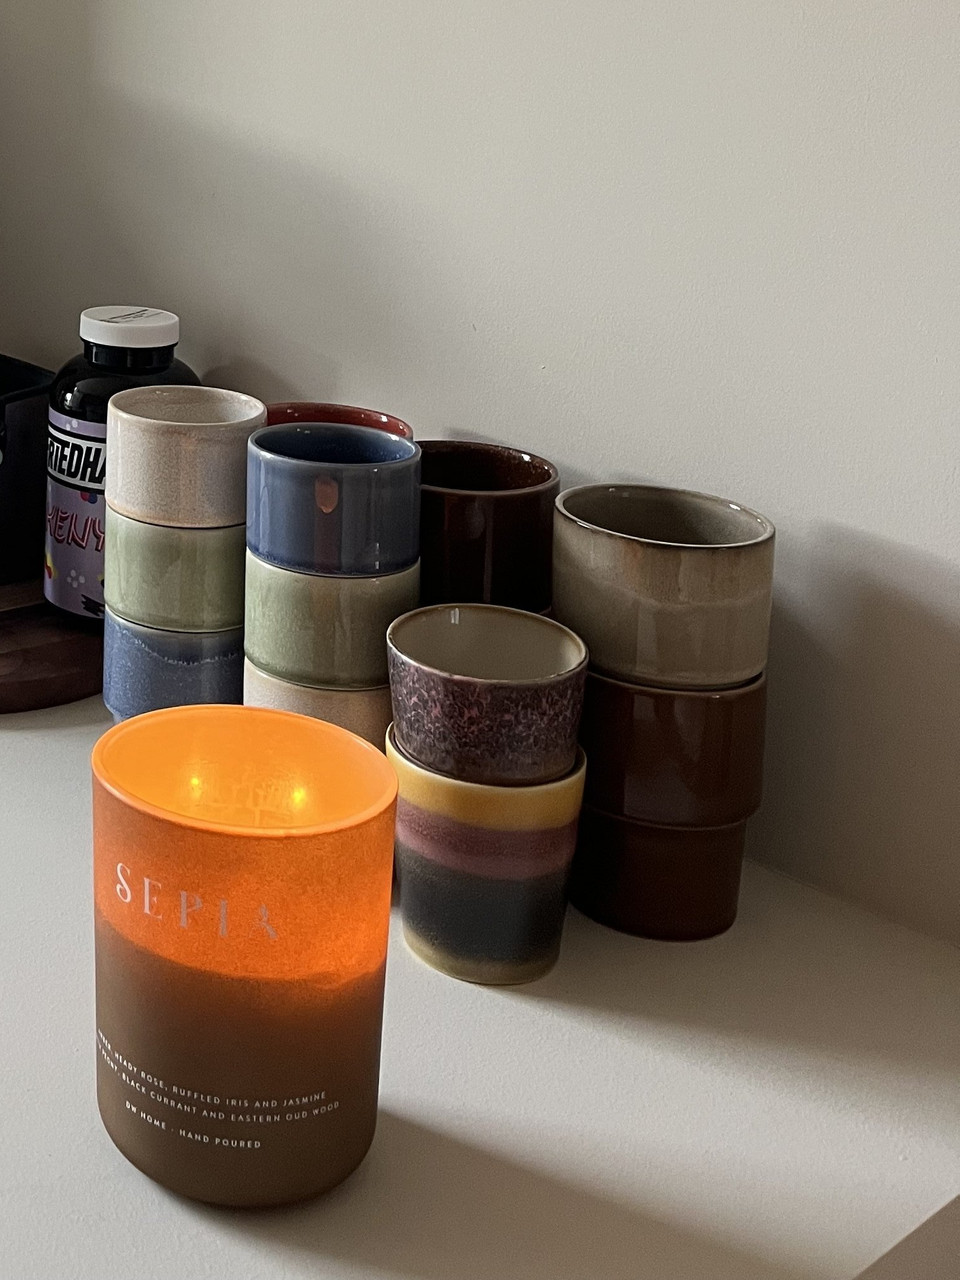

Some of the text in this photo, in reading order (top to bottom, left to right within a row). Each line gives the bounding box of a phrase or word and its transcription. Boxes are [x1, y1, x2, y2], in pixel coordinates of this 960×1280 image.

[48, 437, 106, 485] RIEDH
[115, 862, 278, 940] SEPIA
[114, 1051, 137, 1074] HEADY
[140, 1072, 169, 1092] ROSE,
[172, 1085, 221, 1104] RUFFLED
[226, 1097, 249, 1108] IRIS
[254, 1099, 278, 1108] AND
[282, 1090, 327, 1107] JASMINE
[122, 1072, 146, 1095] BLACK
[150, 1091, 197, 1114] CURRANT
[202, 1109, 225, 1120] AND
[231, 1113, 281, 1123] EASTERN
[285, 1110, 308, 1121] OUD
[312, 1100, 340, 1116] WOOD
[125, 1100, 261, 1148] DW HOME HAND POURED
